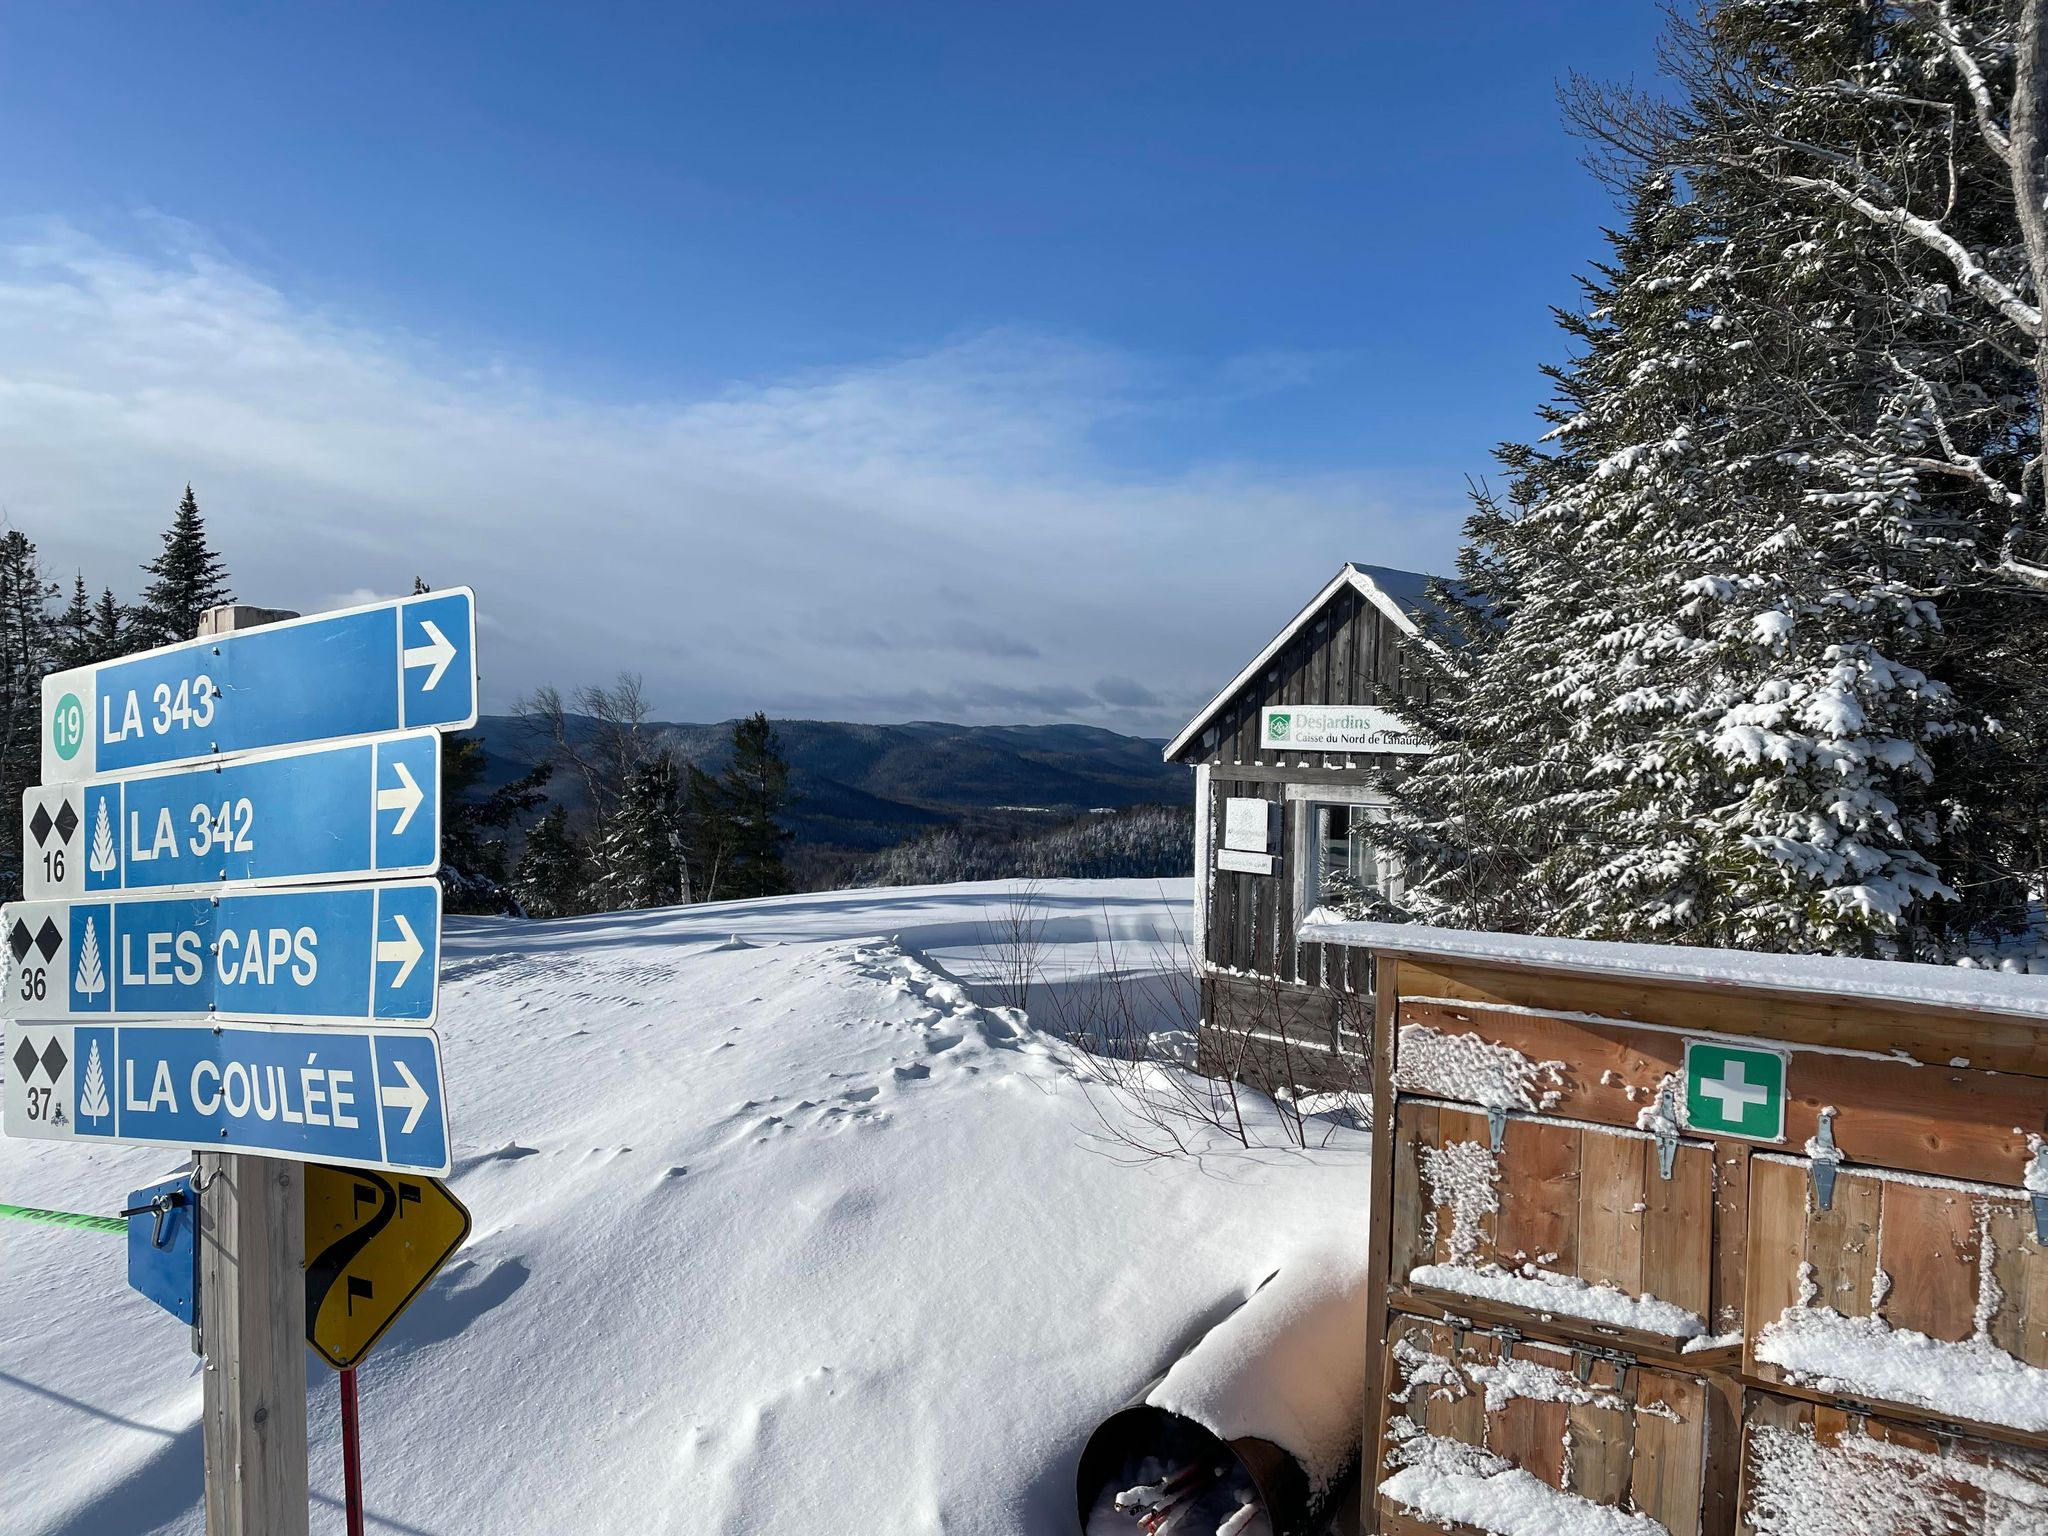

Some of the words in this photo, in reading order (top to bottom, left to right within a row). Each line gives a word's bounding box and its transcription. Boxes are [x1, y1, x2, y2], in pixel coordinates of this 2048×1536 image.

[57, 706, 80, 747] 19
[103, 689, 144, 744] LA
[152, 674, 215, 735] 343
[1296, 714, 1371, 732] Desjardins
[1295, 733, 1324, 743] Caisse
[1326, 734, 1338, 743] du
[1341, 734, 1366, 744] Nord
[1368, 735, 1380, 745] de
[131, 806, 179, 862] LA
[189, 797, 254, 857] 342
[43, 850, 65, 883] 16
[122, 930, 202, 986] LES
[217, 926, 318, 986] CAPS
[20, 967, 47, 1001] 36
[27, 1087, 52, 1121] 37
[126, 1059, 178, 1113] LA
[190, 1052, 359, 1129] COULÉE
